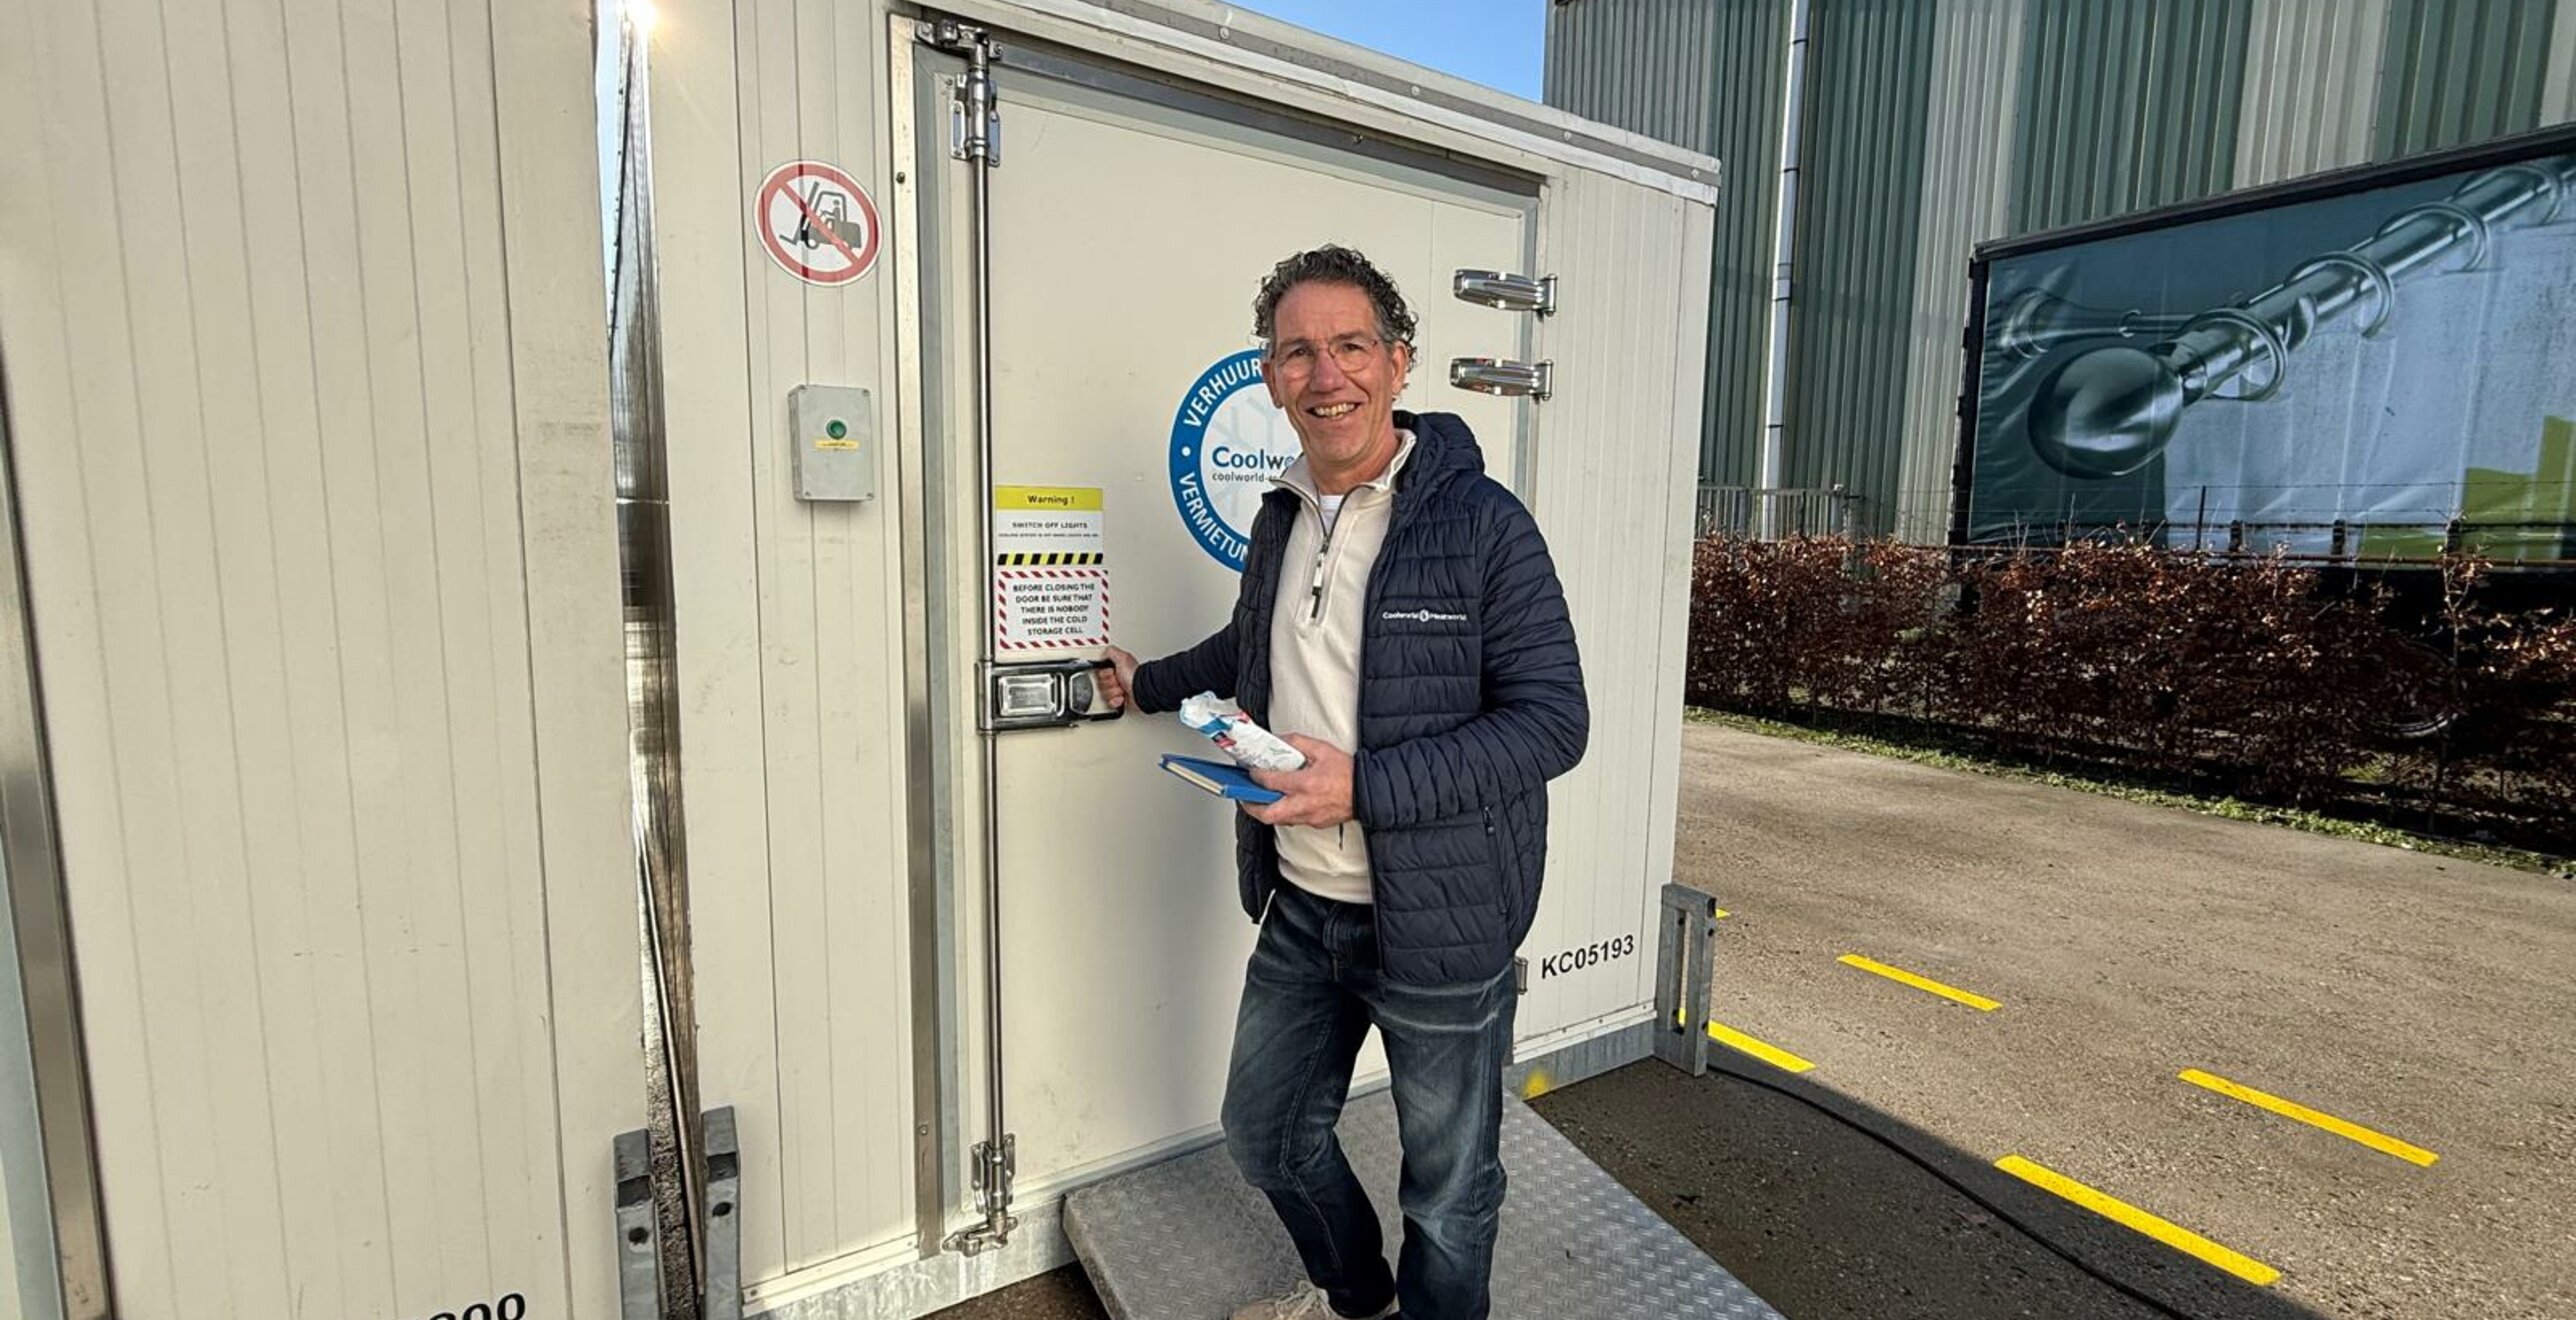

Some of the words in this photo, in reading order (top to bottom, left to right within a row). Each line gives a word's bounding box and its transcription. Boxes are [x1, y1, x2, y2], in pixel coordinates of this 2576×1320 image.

[1183, 357, 1263, 429] VERHUUR
[1211, 446, 1296, 470] Coolwo
[1027, 495, 1069, 506] Warning
[1012, 522, 1043, 530] SWITCH
[1045, 522, 1058, 530] OFF
[1060, 522, 1088, 530] LIGHTS
[1013, 583, 1043, 592] BEFORE
[1045, 583, 1080, 592] CLOSING
[1081, 583, 1095, 591] THE
[1016, 595, 1039, 603] DOOR
[1053, 594, 1072, 602] SURE
[1021, 606, 1046, 614] THERE
[1056, 605, 1089, 613] NOBODY
[1022, 617, 1048, 625] INSIDE
[1050, 616, 1065, 624] THE
[1066, 616, 1088, 624] COLD
[1028, 628, 1063, 636] STORAGE
[1065, 627, 1083, 635] CELL
[1541, 934, 1634, 979] KC05193
